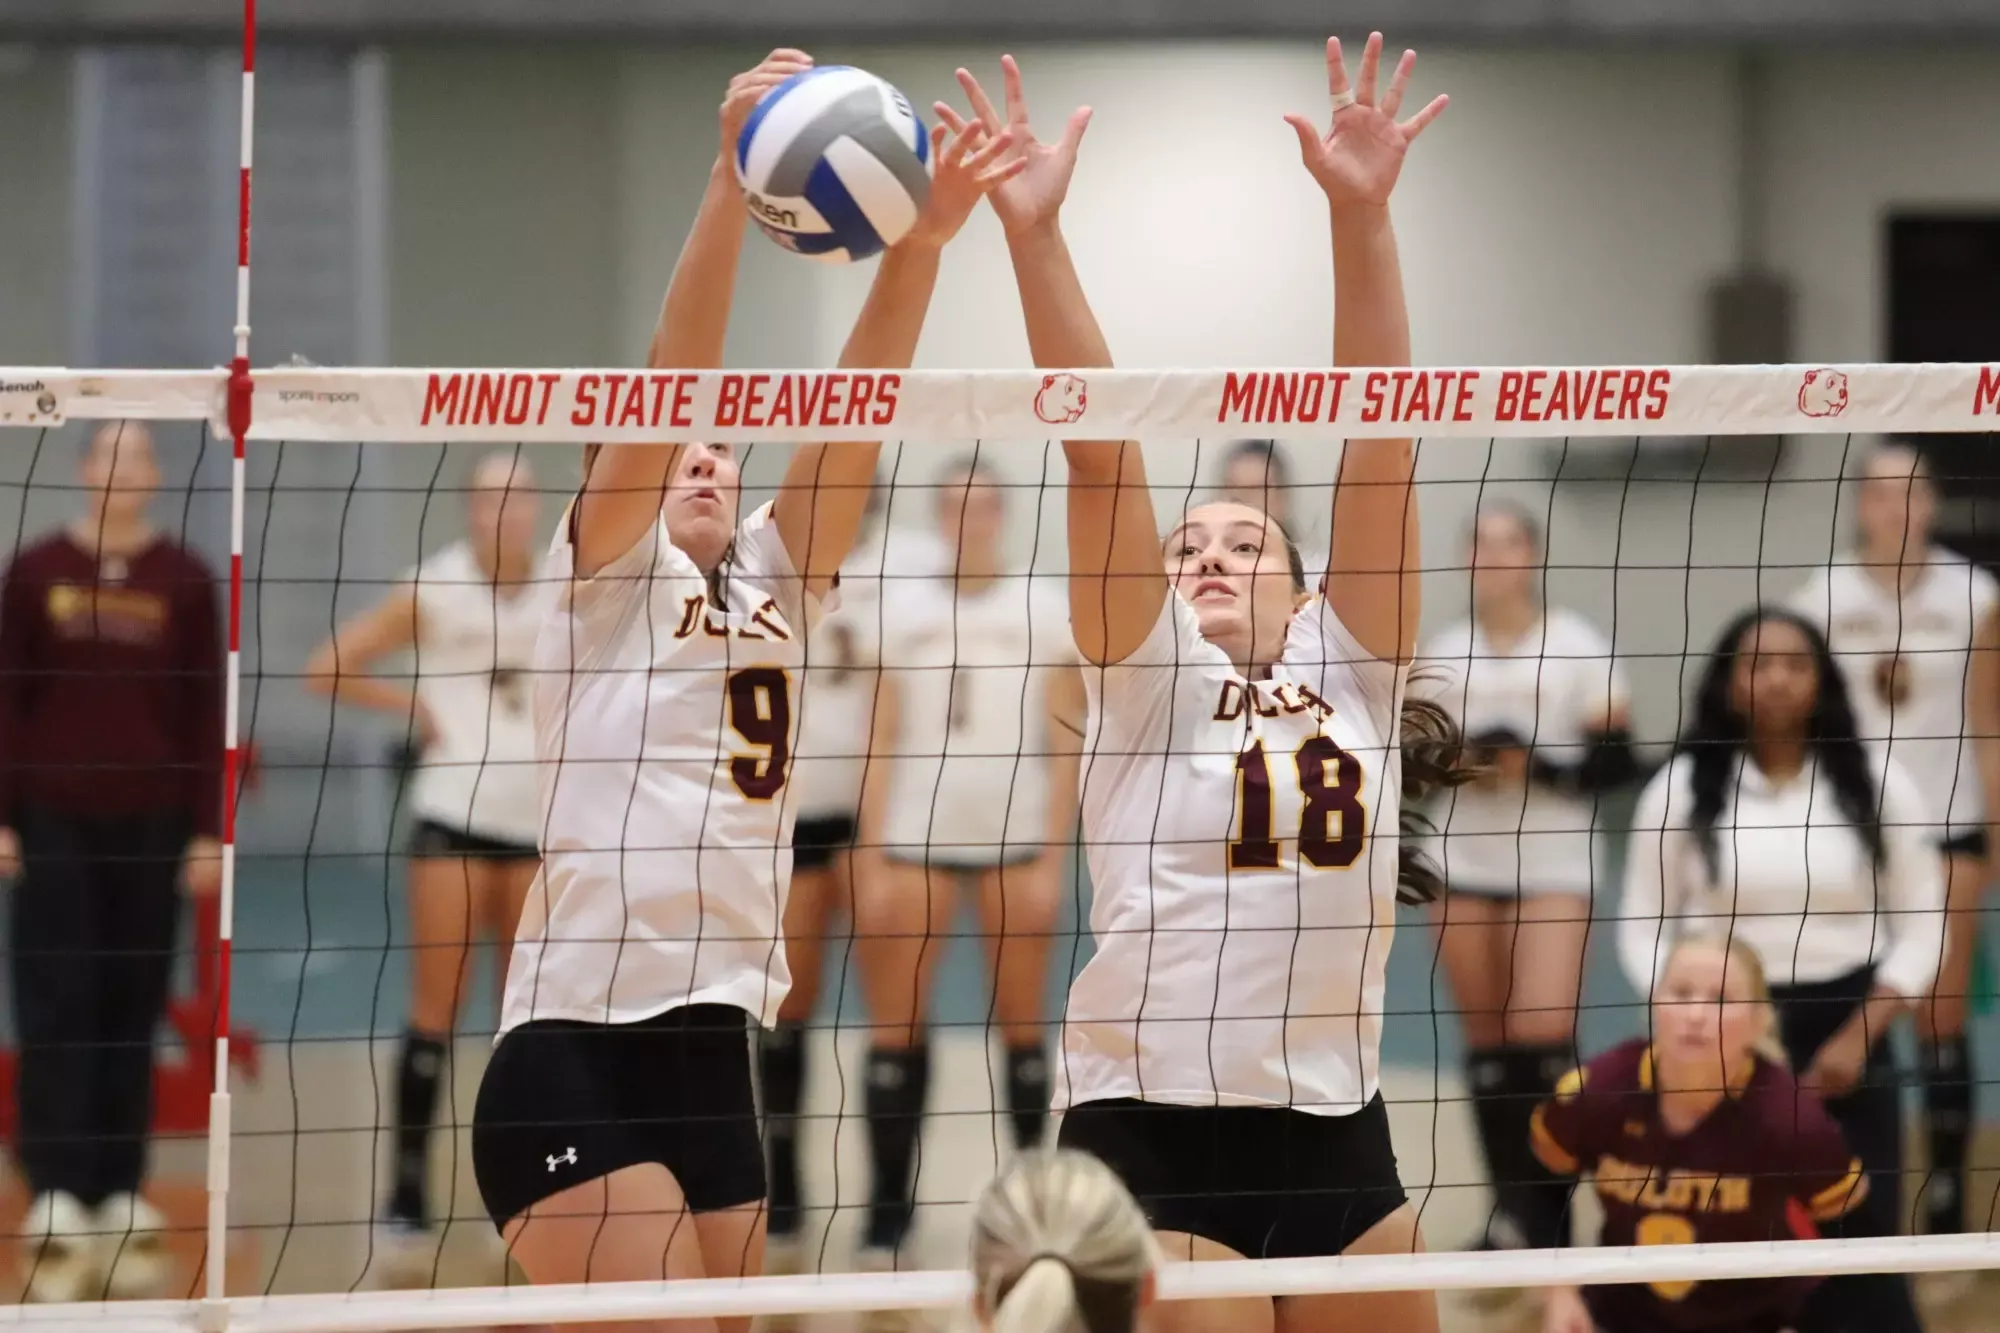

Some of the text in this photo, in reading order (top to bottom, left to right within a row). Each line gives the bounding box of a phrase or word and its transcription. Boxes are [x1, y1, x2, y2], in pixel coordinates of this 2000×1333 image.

[421, 373, 900, 427] MINOT STATE BEAVERS
[1218, 369, 1671, 424] MINOT STATE BEAVERS
[726, 664, 791, 803] 9
[1227, 733, 1368, 871] 18
